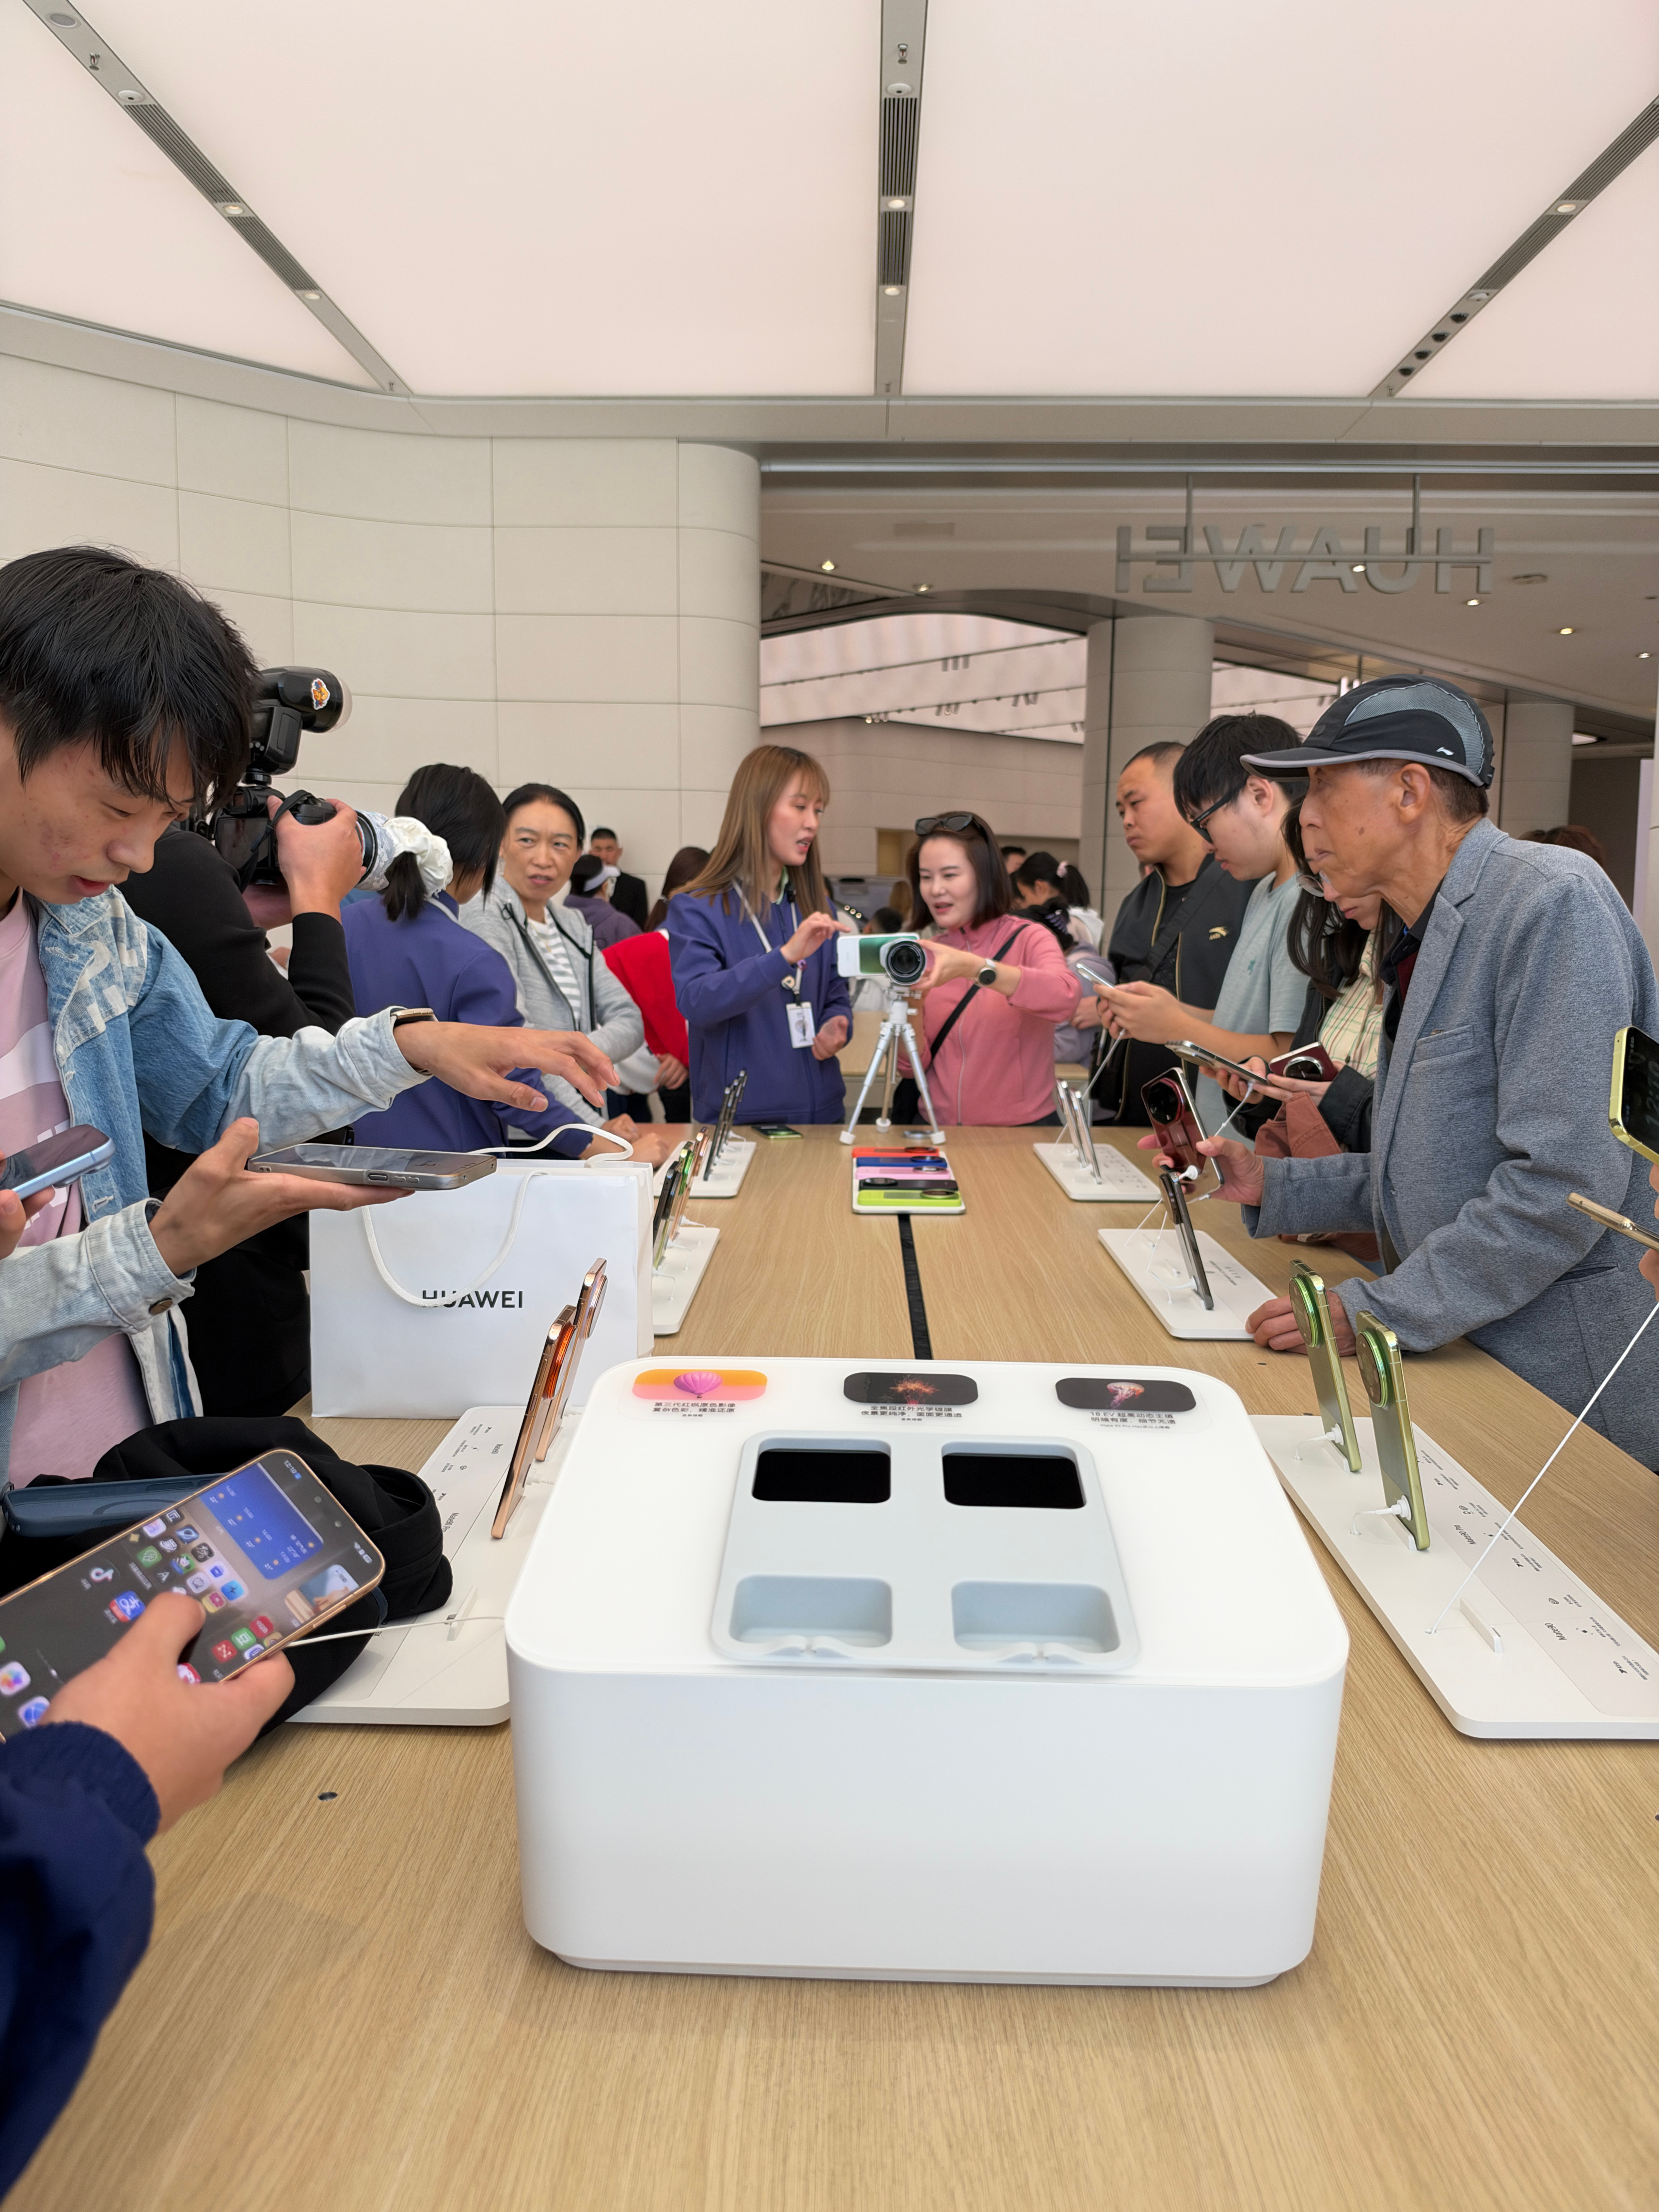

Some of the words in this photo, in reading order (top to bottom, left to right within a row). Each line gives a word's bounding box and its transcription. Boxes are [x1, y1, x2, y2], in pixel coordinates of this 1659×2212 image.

[422, 1290, 523, 1308] HUAWEI
[284, 1460, 297, 1474] 12:10
[1458, 1531, 1477, 1545] Mate90
[1544, 1623, 1567, 1640] Mate90
